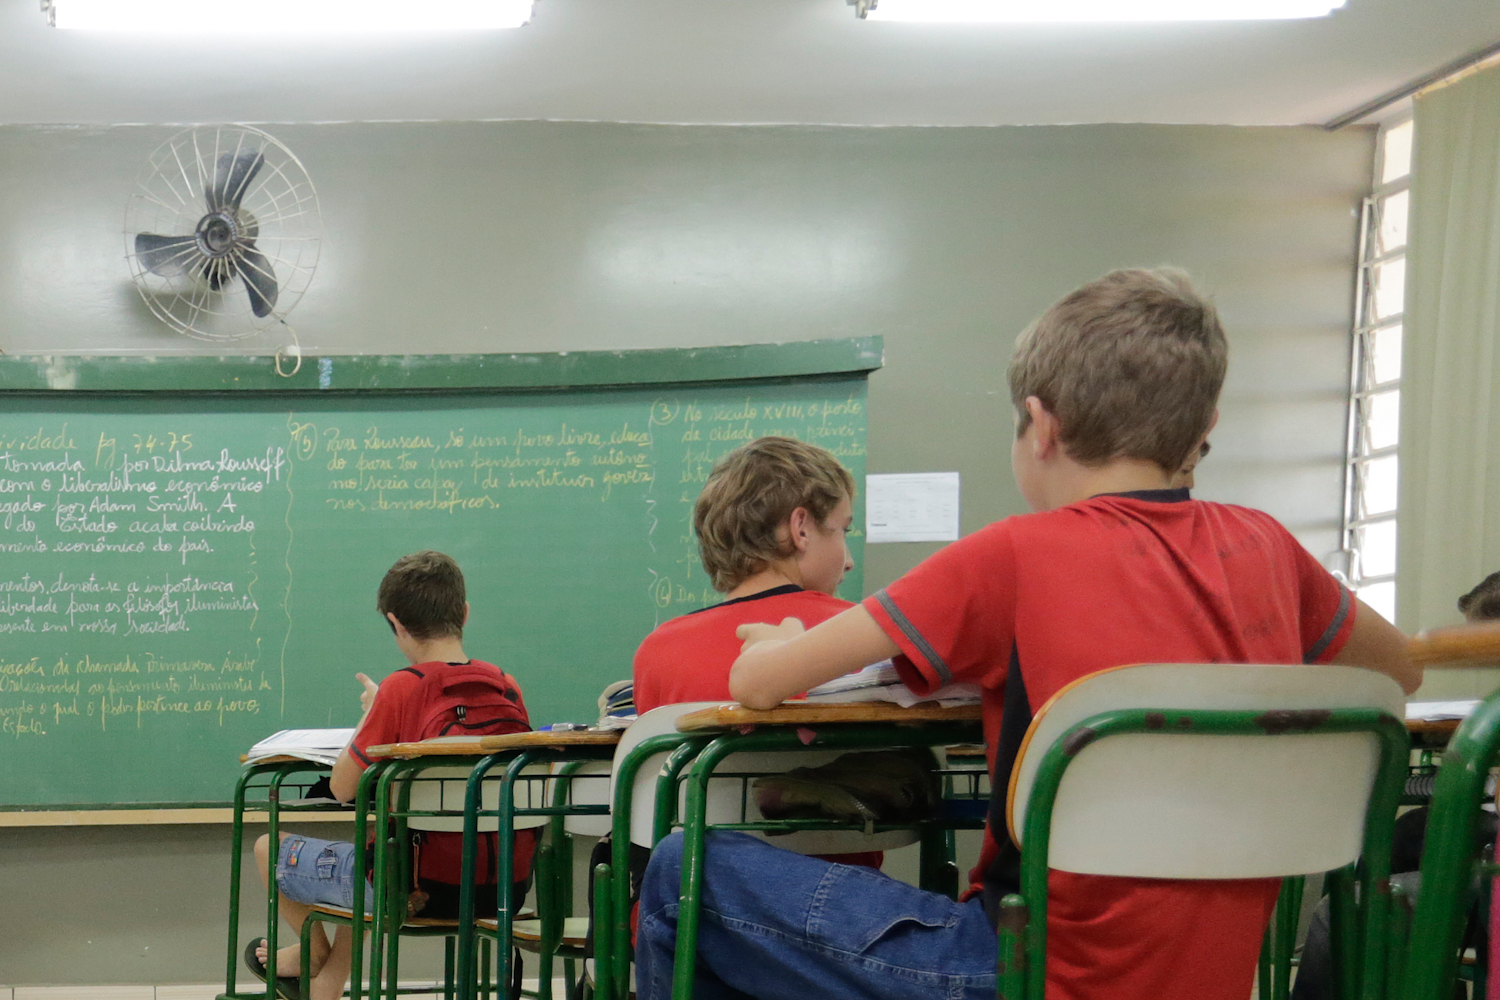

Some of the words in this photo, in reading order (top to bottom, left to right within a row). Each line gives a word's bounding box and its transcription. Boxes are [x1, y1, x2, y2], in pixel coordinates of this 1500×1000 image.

[513, 428, 555, 455] povo
[0, 451, 86, 472] tomada
[117, 453, 149, 485] por
[151, 450, 215, 472] Dilma
[327, 452, 347, 470] do
[356, 452, 393, 485] para
[0, 478, 36, 492] com
[41, 477, 51, 491] o
[58, 471, 158, 492] liberalismo
[482, 468, 498, 489] de
[52, 494, 85, 527] por
[89, 495, 136, 513] Adam
[217, 492, 237, 513] A
[326, 498, 366, 511] nos
[16, 514, 36, 532] do
[129, 513, 179, 532] acaba
[183, 513, 256, 532] coibindo
[153, 537, 172, 551] do
[127, 581, 140, 592] a
[66, 592, 99, 627] para
[41, 621, 67, 632] em
[194, 701, 212, 711] ao
